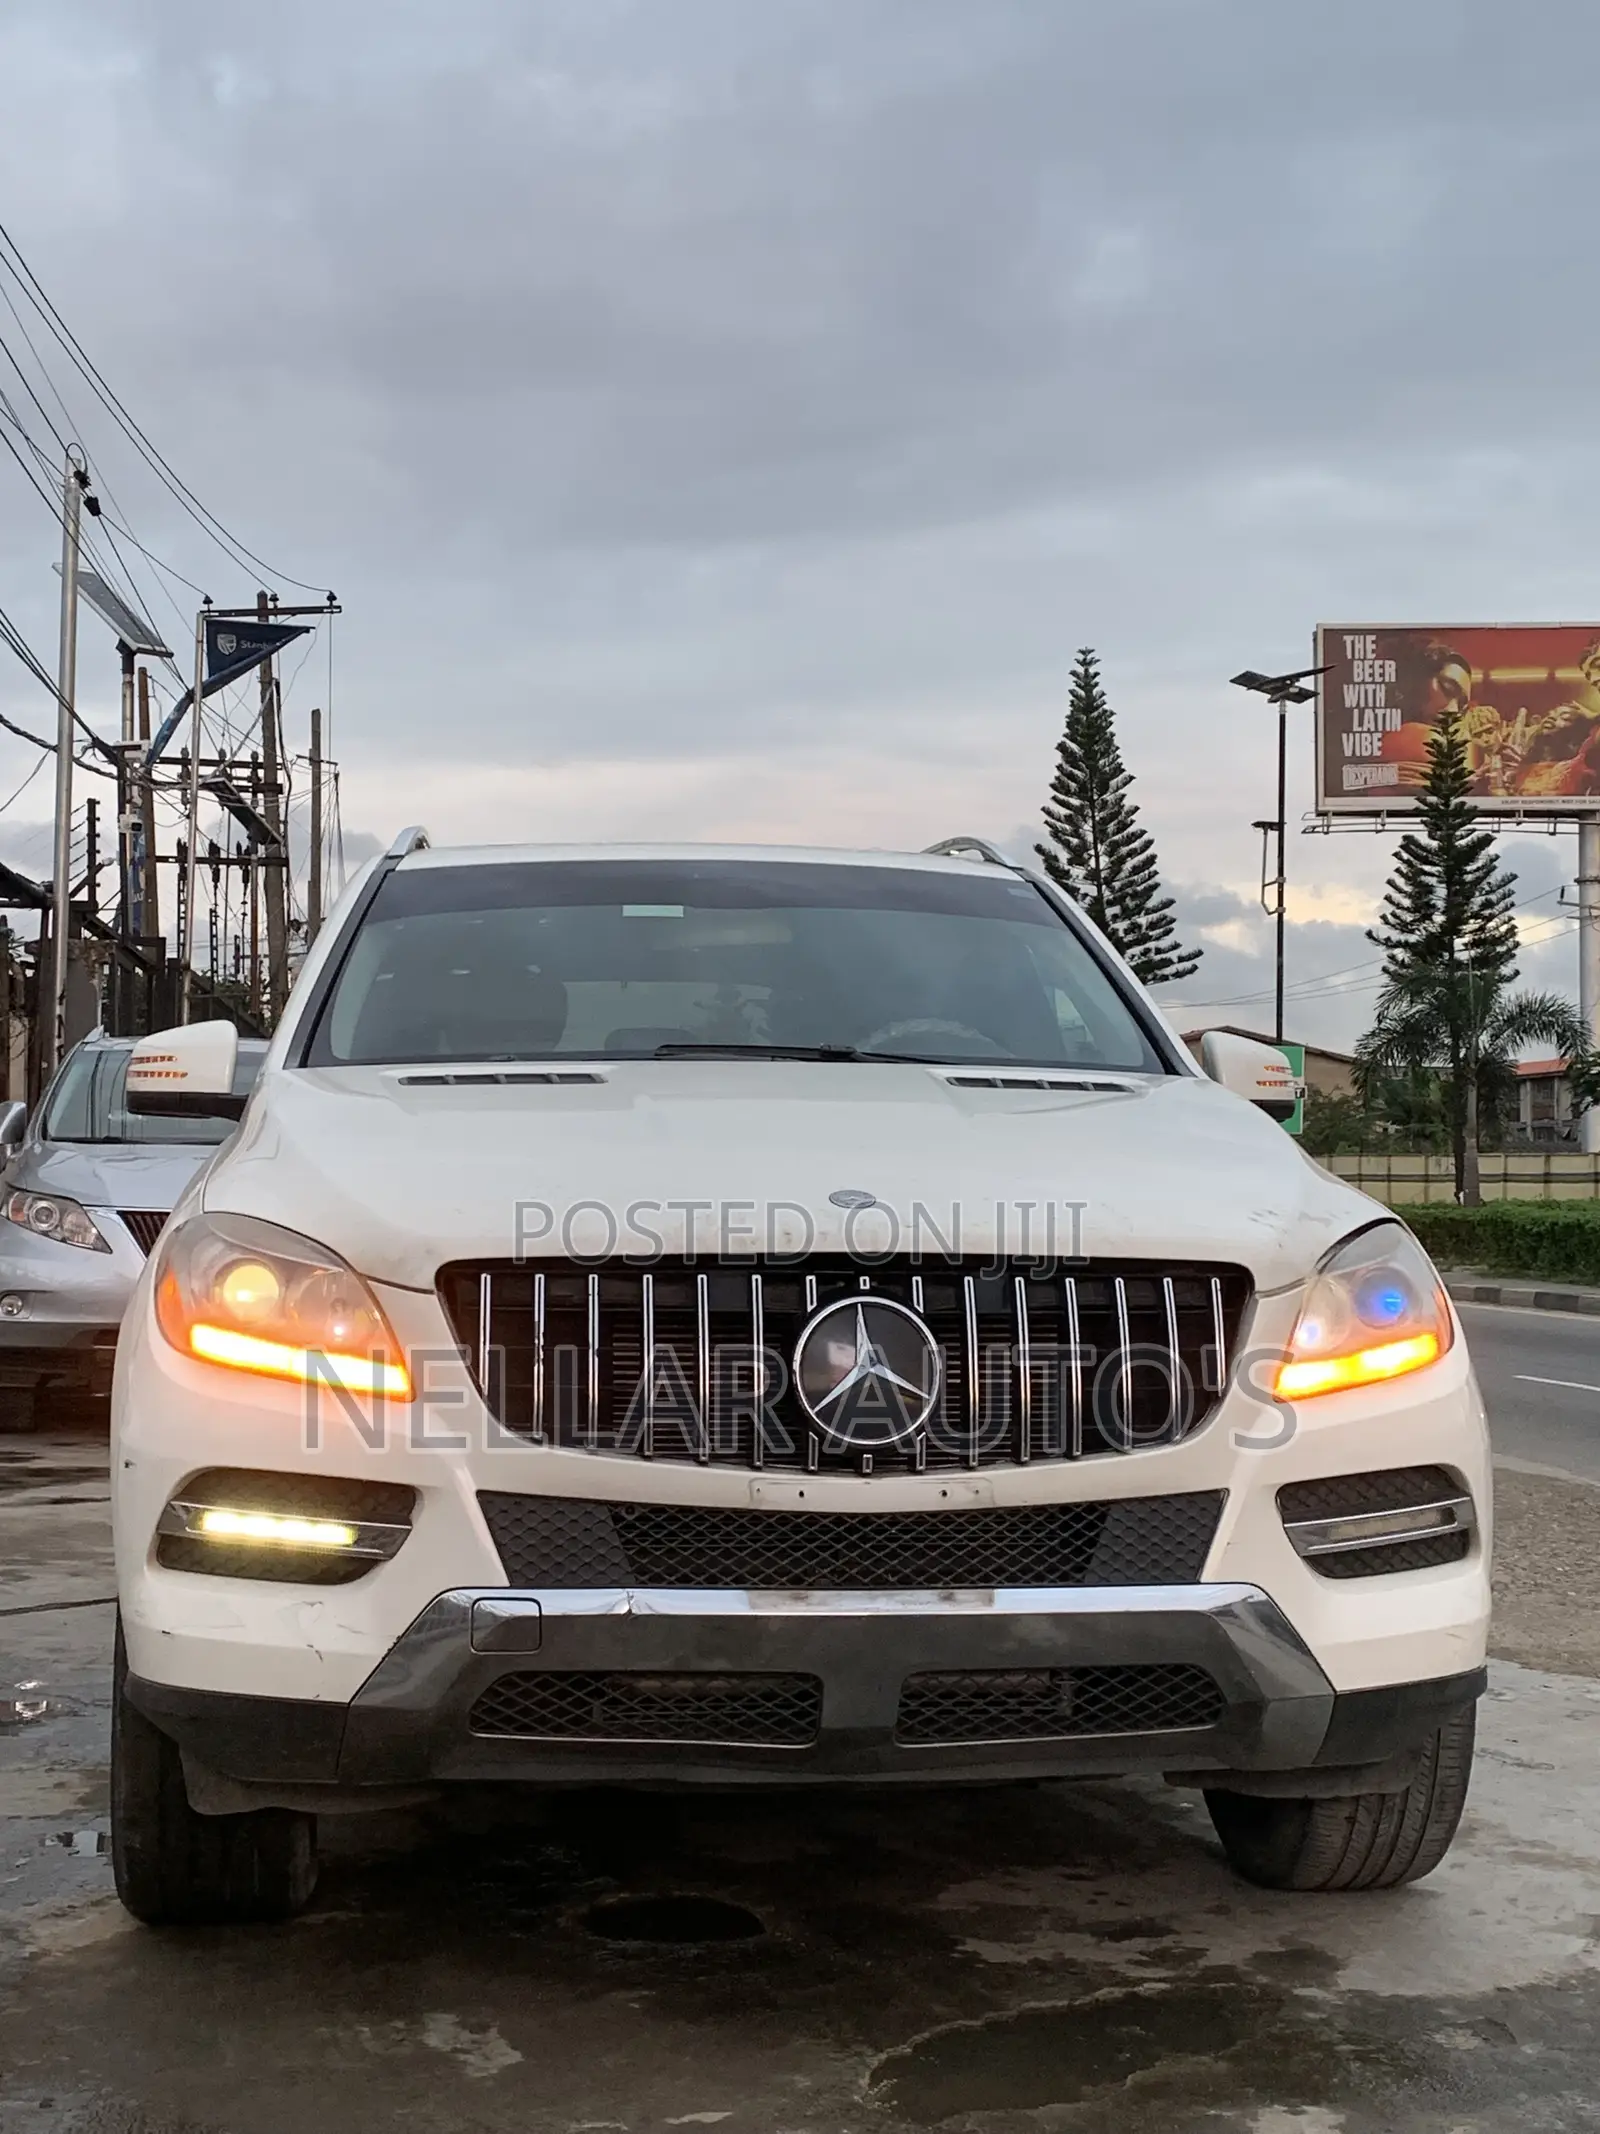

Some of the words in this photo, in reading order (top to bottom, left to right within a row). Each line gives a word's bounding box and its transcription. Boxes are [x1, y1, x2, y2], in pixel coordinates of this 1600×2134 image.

[1343, 635, 1377, 659] THE
[1353, 660, 1396, 682] BEER
[1343, 684, 1385, 708] WITH
[1353, 708, 1401, 732] LATIN
[1341, 733, 1382, 756] VIBE
